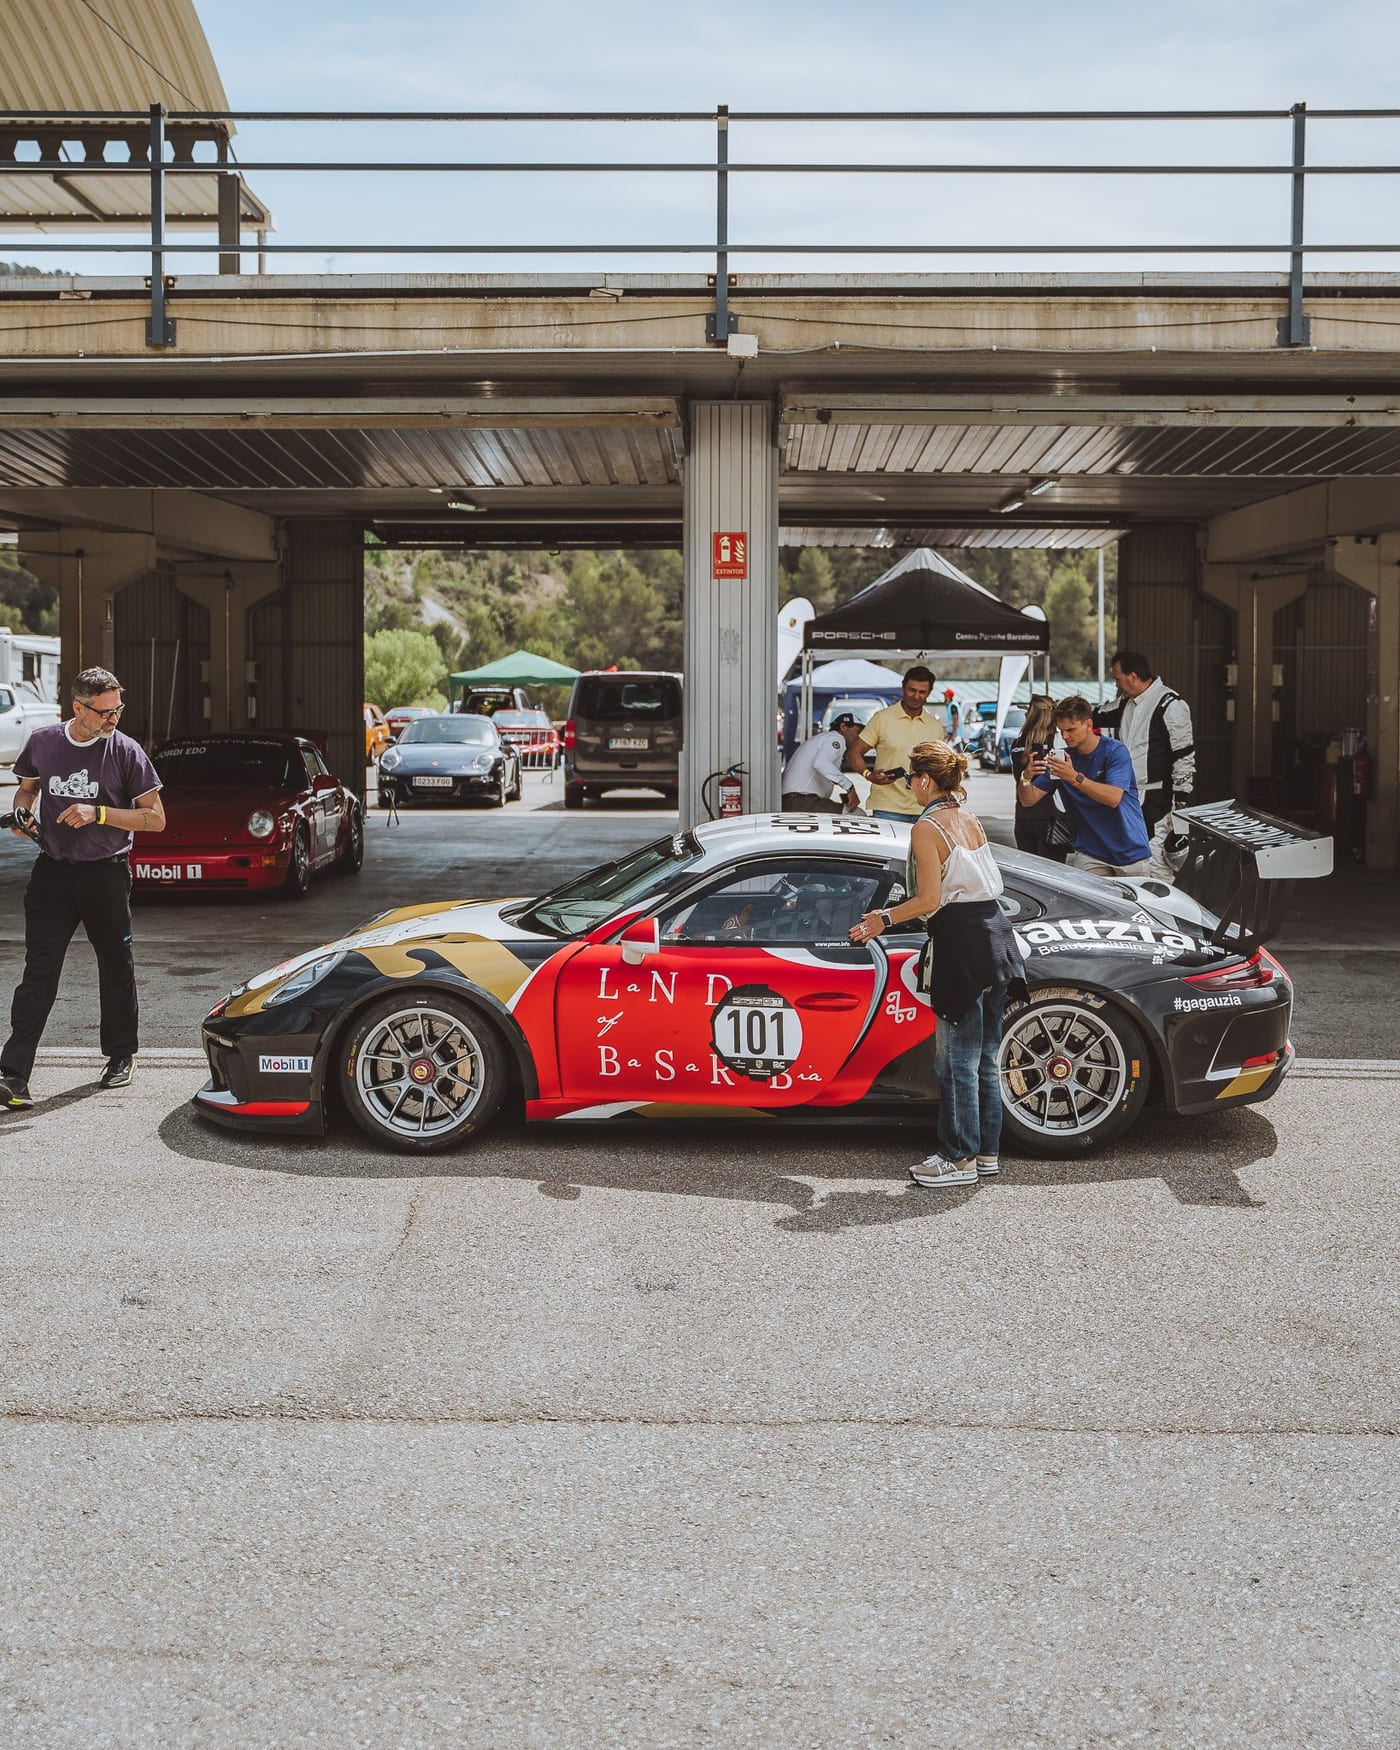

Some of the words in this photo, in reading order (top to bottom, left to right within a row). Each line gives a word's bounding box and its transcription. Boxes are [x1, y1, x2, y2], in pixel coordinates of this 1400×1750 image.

[812, 631, 896, 640] PORSCHE
[1007, 633, 1040, 641] Barcelona
[185, 746, 207, 755] EDO
[136, 864, 181, 879] Mobil
[186, 864, 202, 879] 1
[1012, 914, 1197, 960] auzia
[1173, 993, 1242, 1012] #gagauzia
[597, 1010, 624, 1037] of
[727, 1009, 785, 1056] 101
[261, 1058, 295, 1070] Mobil
[297, 1059, 308, 1070] 1
